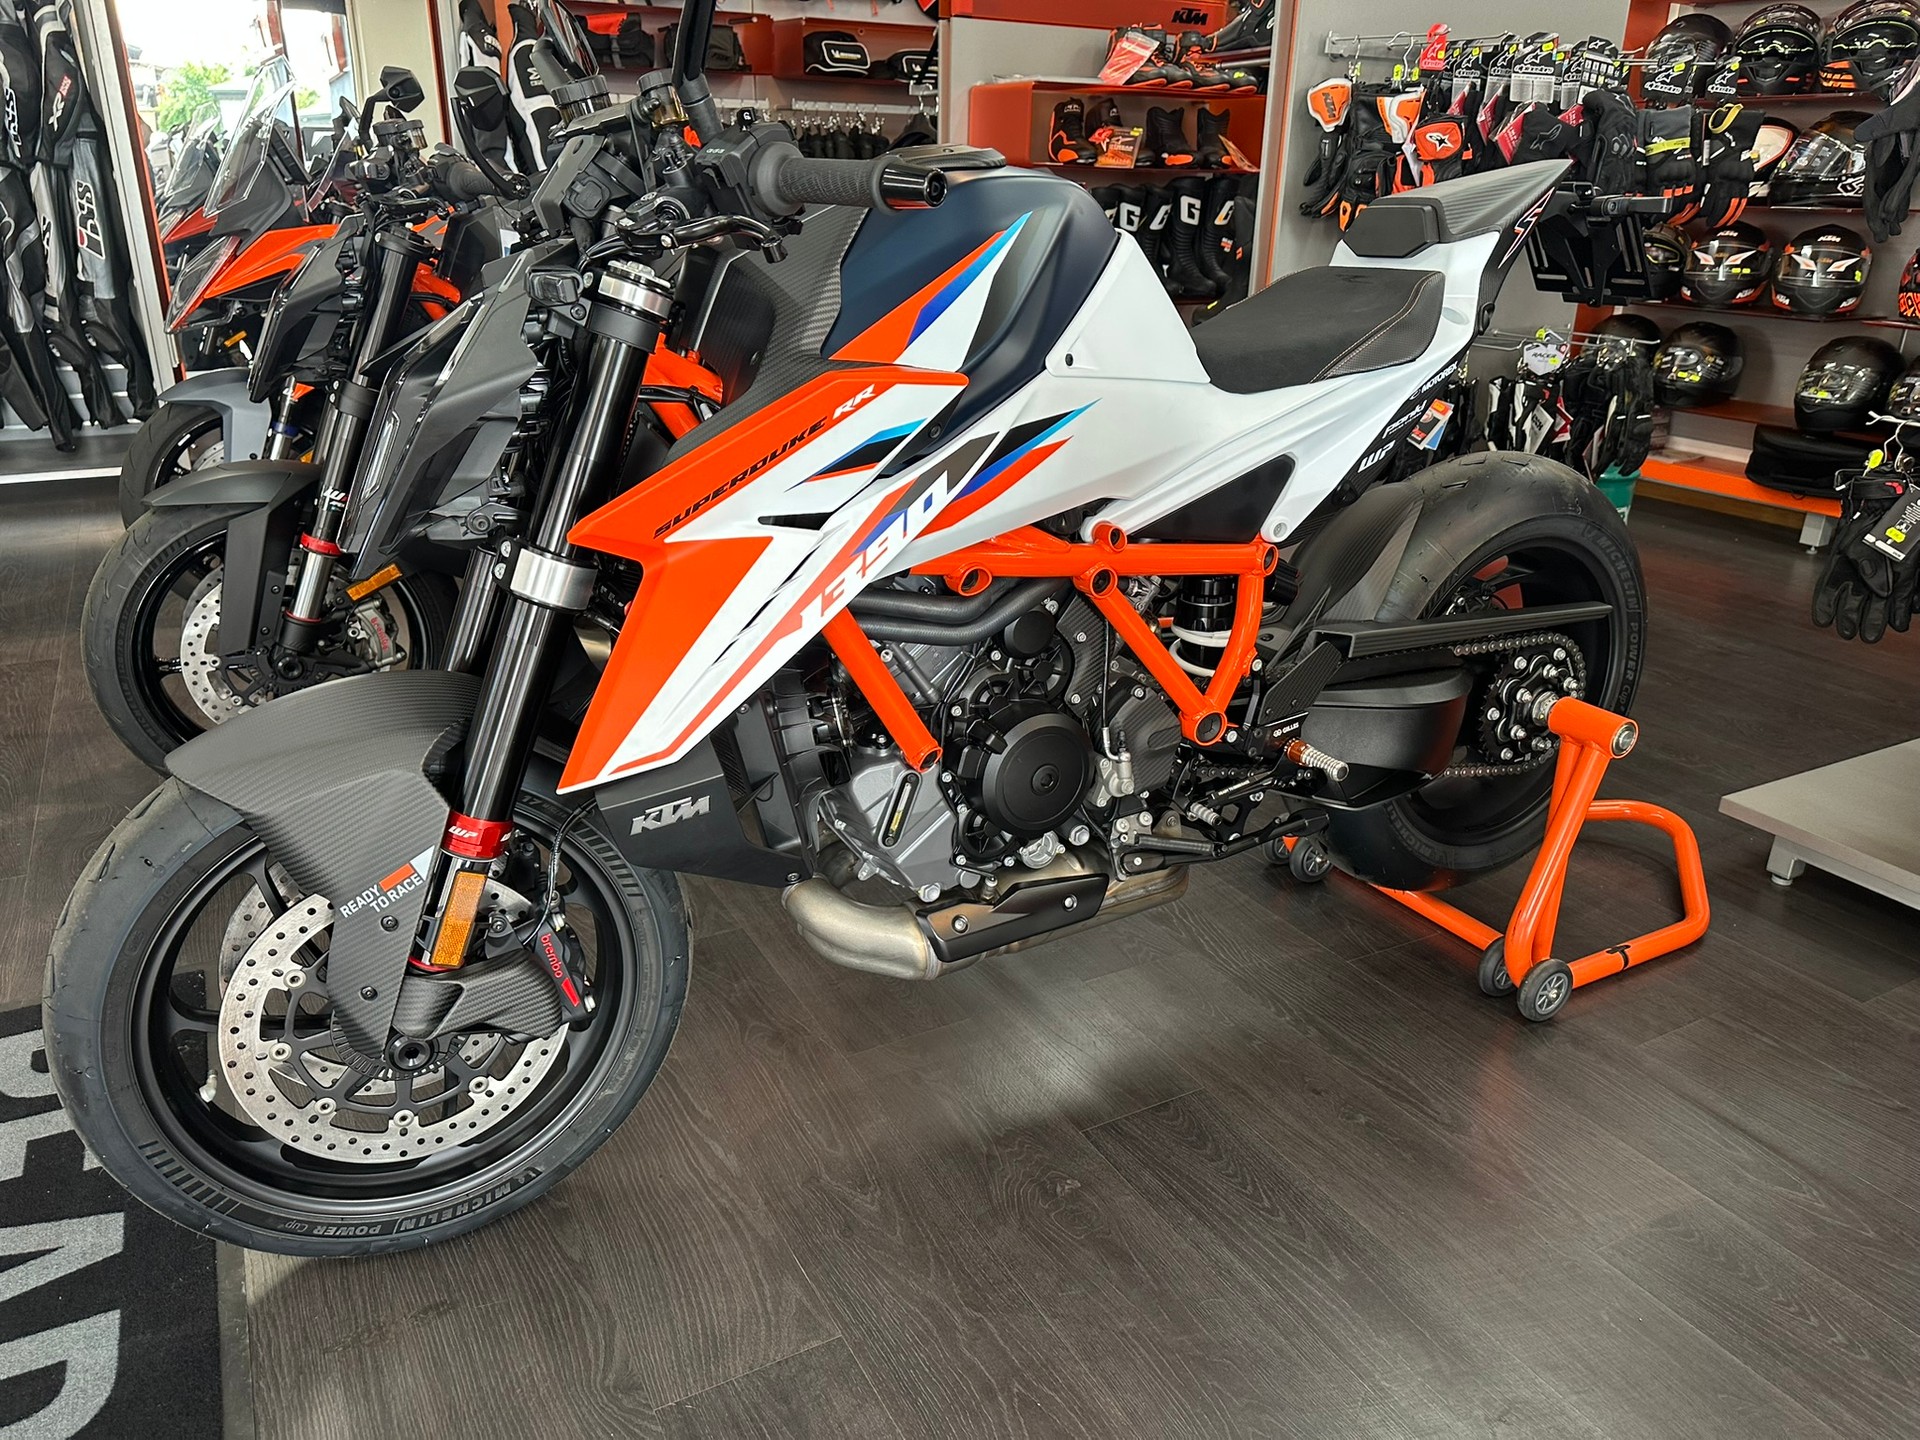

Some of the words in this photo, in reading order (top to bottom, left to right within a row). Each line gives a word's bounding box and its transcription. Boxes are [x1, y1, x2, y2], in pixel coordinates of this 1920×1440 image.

[1171, 7, 1208, 26] KTM
[1421, 361, 1459, 393] MOTOREX
[832, 383, 876, 420] RR
[1358, 440, 1396, 474] WP
[1625, 621, 1639, 681] POWER
[448, 825, 479, 839] WP
[630, 795, 710, 836] KTM
[339, 884, 381, 919] READY
[369, 894, 390, 913] TO
[388, 873, 424, 903] RACE
[541, 933, 563, 978] brembo
[399, 1181, 512, 1232] MICHELIN
[284, 1219, 309, 1232] Cup
[312, 1223, 383, 1236] POWER
